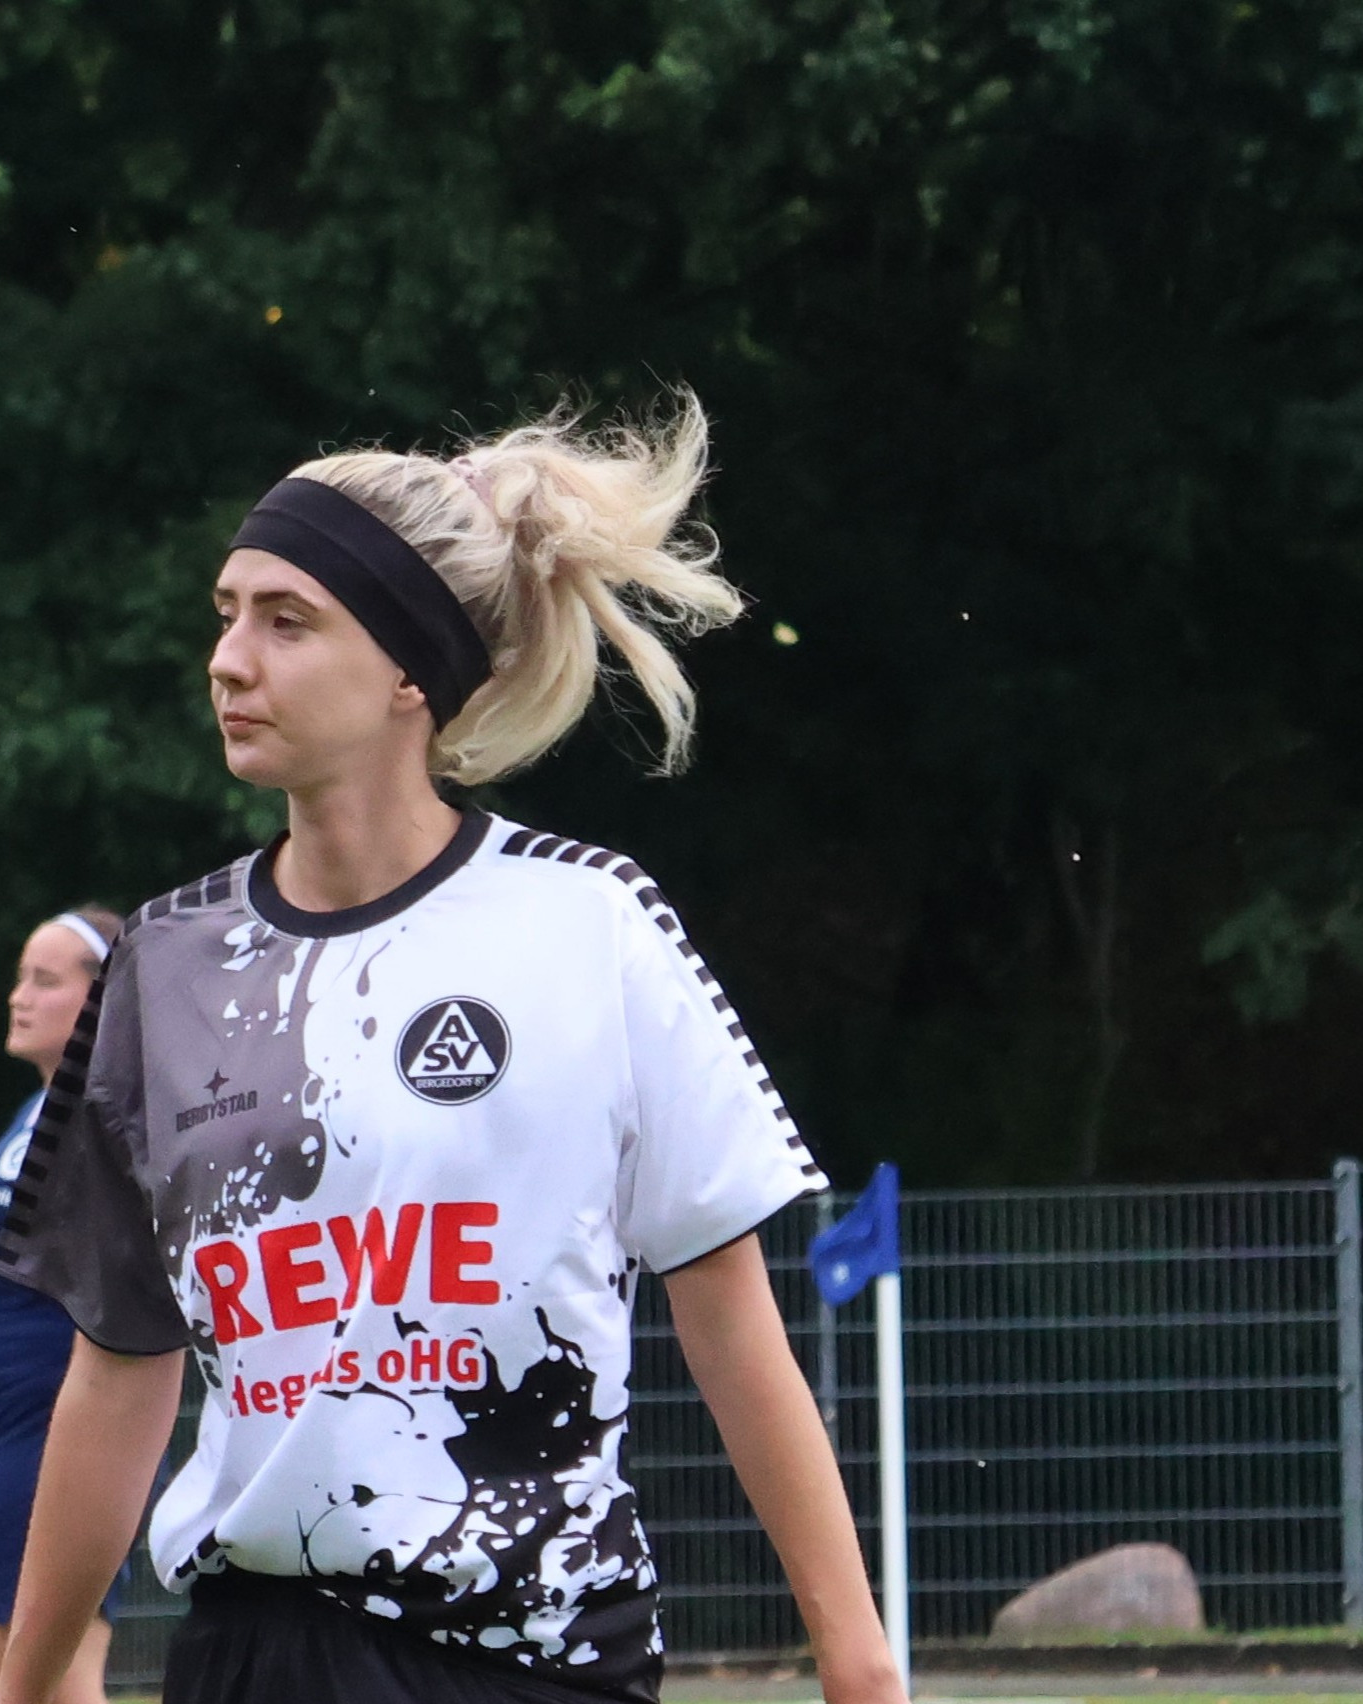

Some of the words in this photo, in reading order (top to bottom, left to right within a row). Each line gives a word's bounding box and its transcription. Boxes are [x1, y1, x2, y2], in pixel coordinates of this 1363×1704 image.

[176, 1090, 258, 1133] DERBYSTAR
[194, 1202, 501, 1345] REWE
[376, 1338, 480, 1384] oHG
